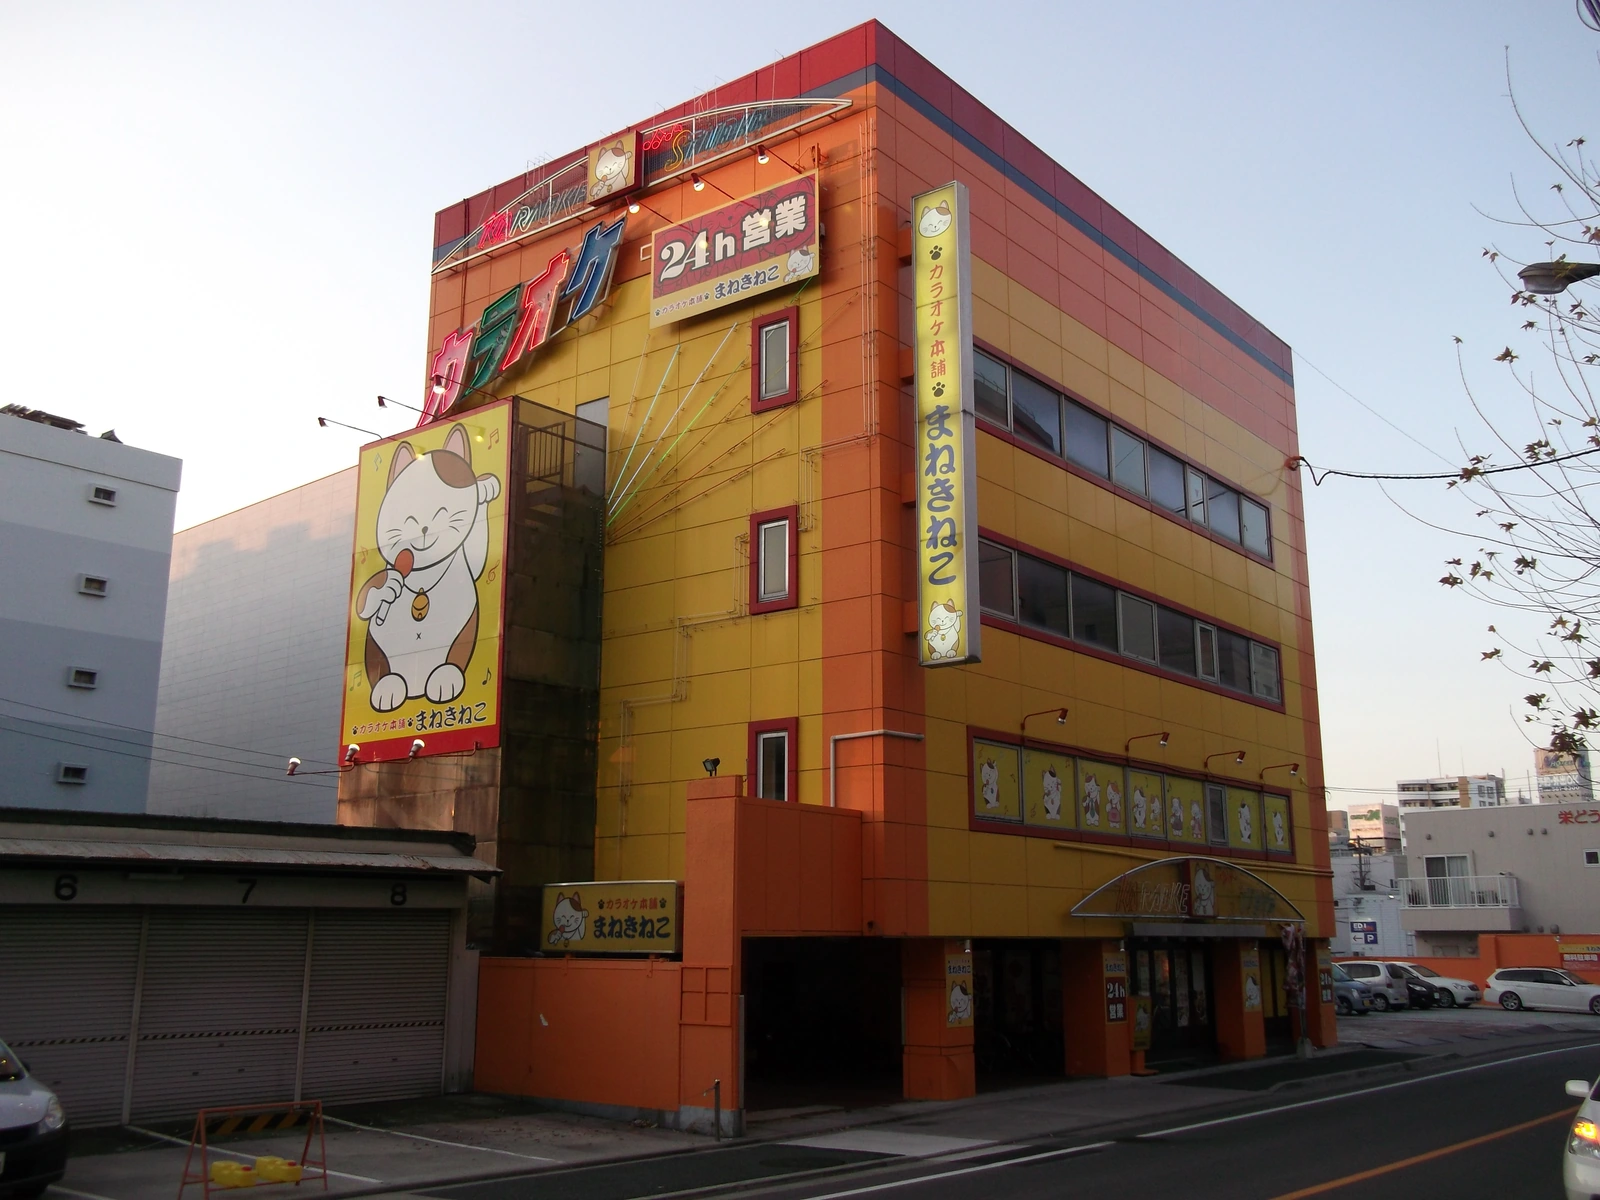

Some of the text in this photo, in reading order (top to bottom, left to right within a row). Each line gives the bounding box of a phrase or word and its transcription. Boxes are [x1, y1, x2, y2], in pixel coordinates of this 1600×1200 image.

[661, 264, 780, 315] カラオケ本舗 まねきねこ
[418, 214, 627, 427] カラオケ
[929, 264, 946, 379] カラオケ本舗
[924, 404, 958, 586] まねきねこ
[359, 701, 488, 735] カラオケ本舗 まねきねこ
[54, 873, 79, 901] 6
[237, 878, 258, 904] 7
[390, 882, 408, 906] 8
[606, 897, 658, 910] カラオケ本舗
[593, 915, 672, 940] まねきねこ
[1366, 934, 1375, 943] P
[1107, 982, 1125, 998] 24h
